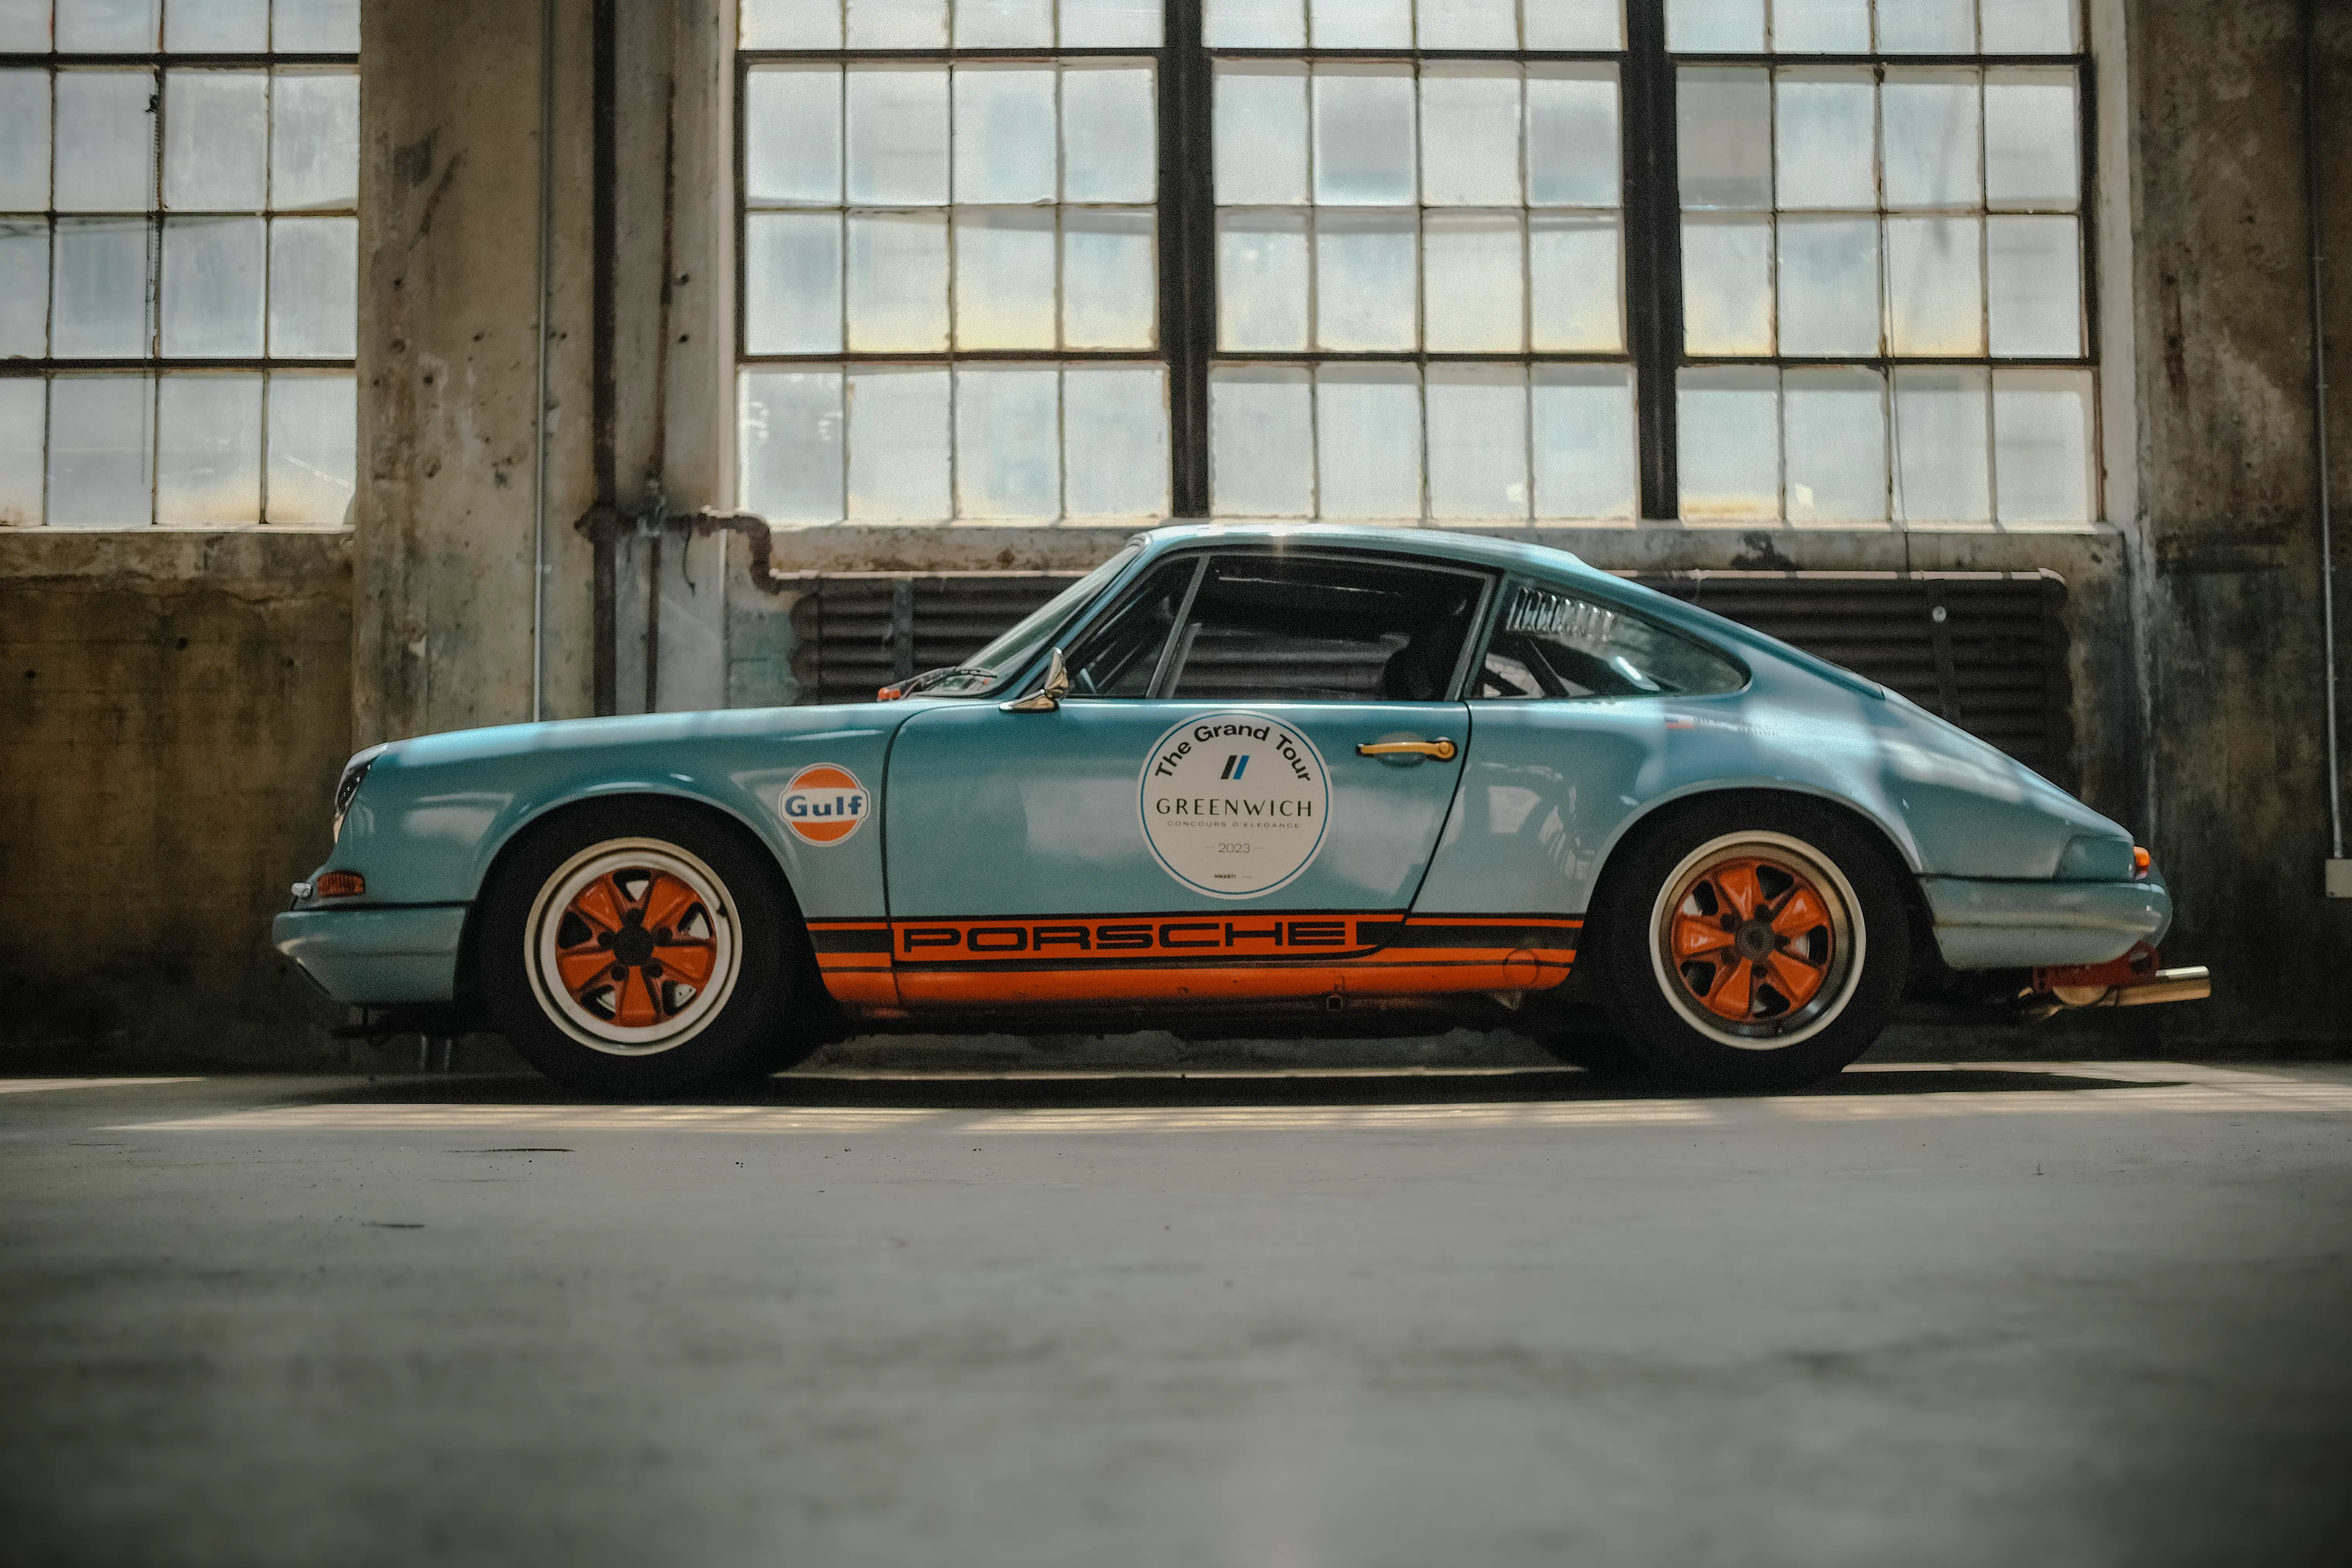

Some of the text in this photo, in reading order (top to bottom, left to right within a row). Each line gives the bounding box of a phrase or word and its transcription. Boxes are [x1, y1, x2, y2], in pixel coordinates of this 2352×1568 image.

[1155, 725, 1311, 781] The Grand Tour
[785, 795, 862, 817] Gulf
[1156, 798, 1312, 817] GREENWICH
[1218, 843, 1251, 853] 2023
[904, 921, 1346, 953] PORSCHE
